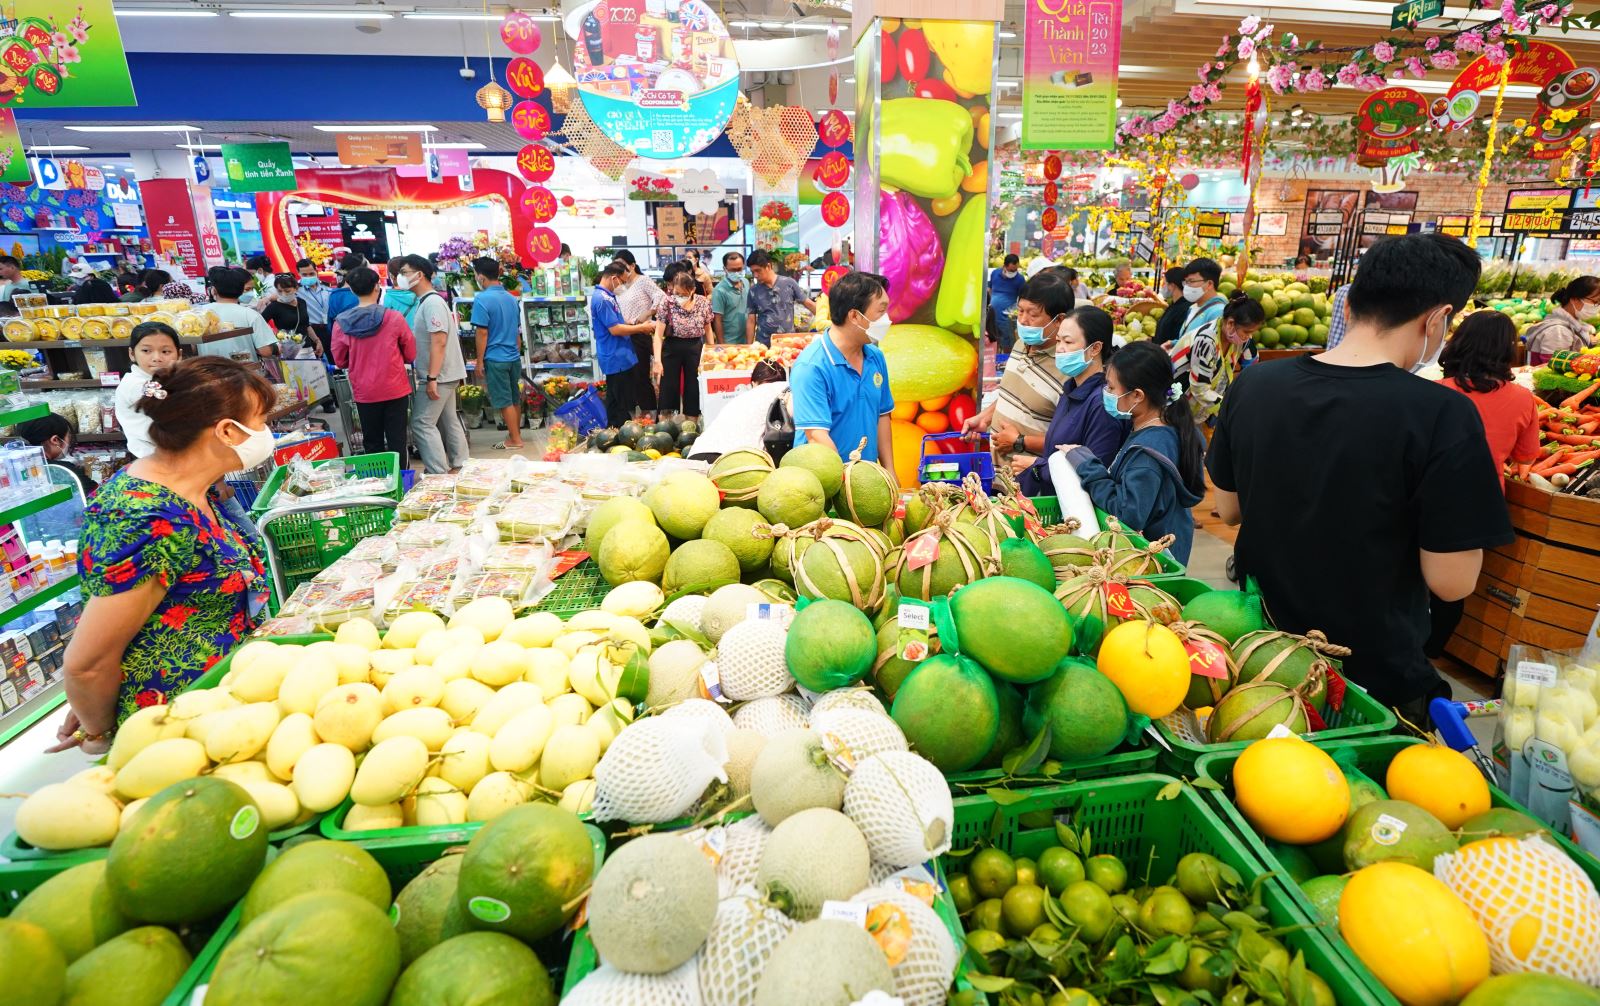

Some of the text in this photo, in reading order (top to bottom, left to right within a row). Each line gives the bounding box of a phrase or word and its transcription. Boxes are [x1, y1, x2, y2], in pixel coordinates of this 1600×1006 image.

[1424, 0, 1436, 12] EXIT
[610, 7, 637, 22] 2023
[1038, 19, 1084, 40] Thành
[1091, 28, 1107, 39] 20
[1091, 43, 1107, 54] 23
[1048, 45, 1083, 64] Viên
[1383, 91, 1408, 99] 2023
[206, 247, 220, 256] QUÀ
[903, 612, 924, 621] Select
[1189, 648, 1221, 669] Tài
